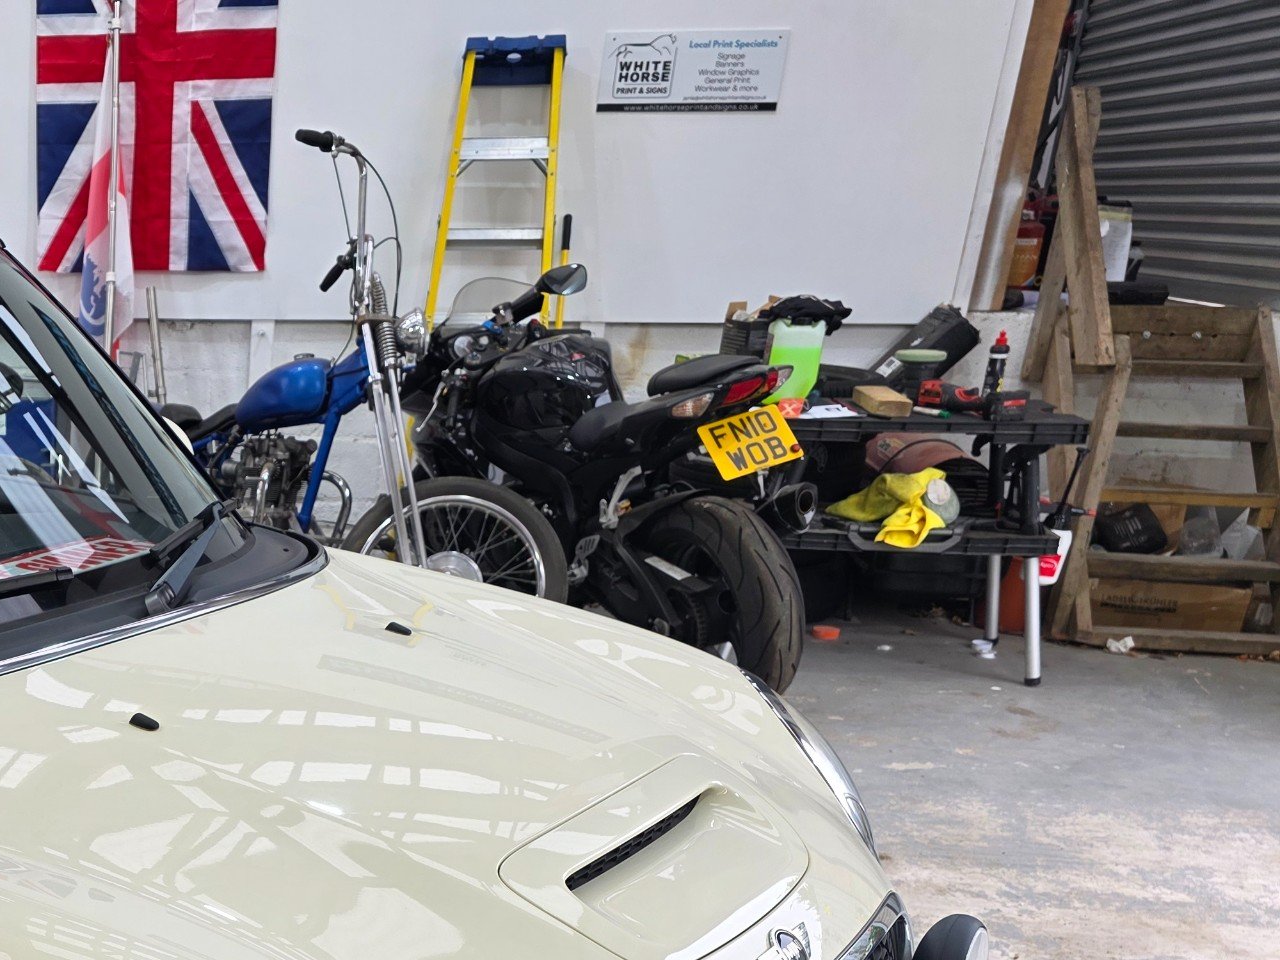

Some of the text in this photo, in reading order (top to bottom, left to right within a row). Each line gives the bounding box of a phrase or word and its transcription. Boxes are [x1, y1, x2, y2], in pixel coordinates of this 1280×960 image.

[689, 40, 778, 49] Local Print Specialists
[717, 52, 746, 60] Signage
[619, 60, 672, 71] WHITE
[618, 71, 670, 83] HORSE
[727, 68, 760, 77] Graphics
[645, 86, 668, 94] SIGNS
[725, 436, 788, 472] WOB
